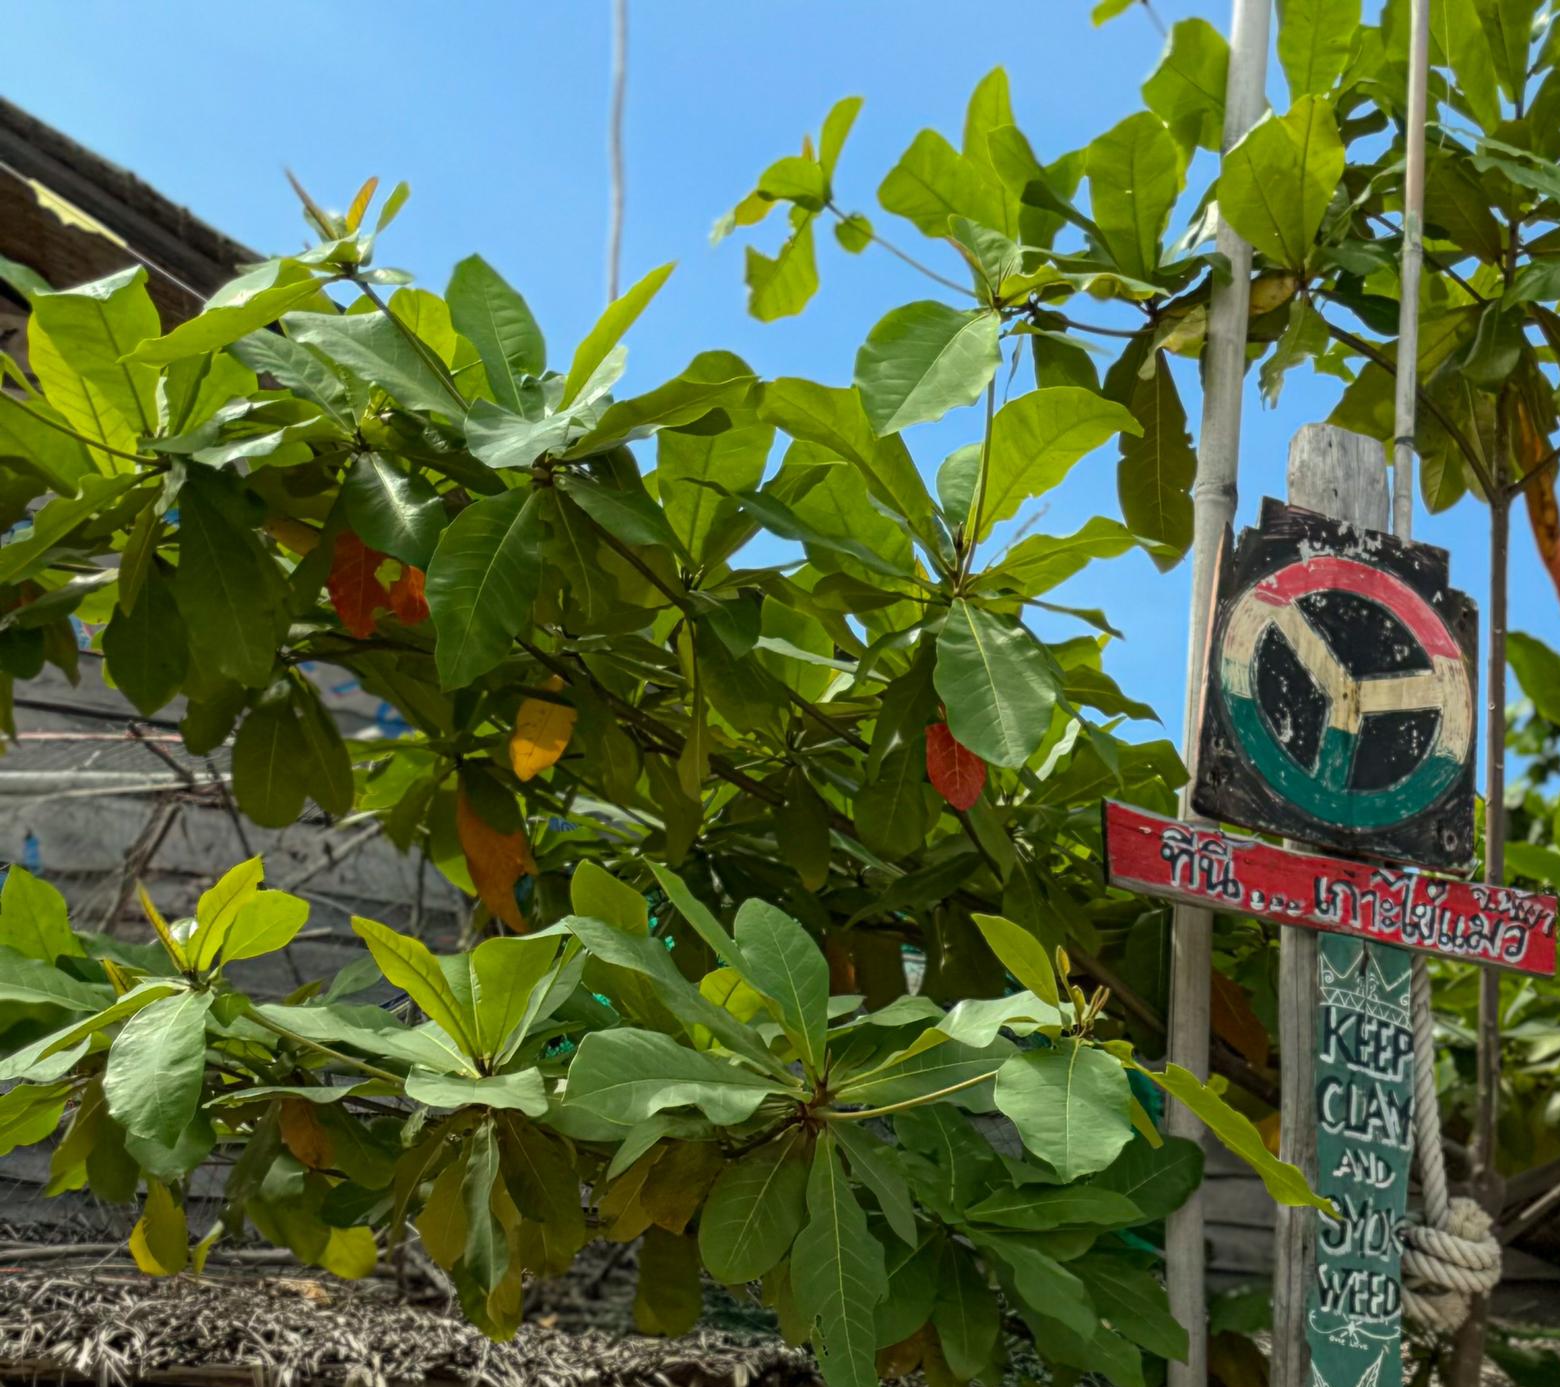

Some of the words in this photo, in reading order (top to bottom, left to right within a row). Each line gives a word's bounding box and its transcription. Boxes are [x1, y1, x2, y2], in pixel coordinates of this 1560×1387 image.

[1318, 1006, 1415, 1082] KEEP
[1332, 1146, 1396, 1189] AND
[1317, 1263, 1403, 1323] WEED
